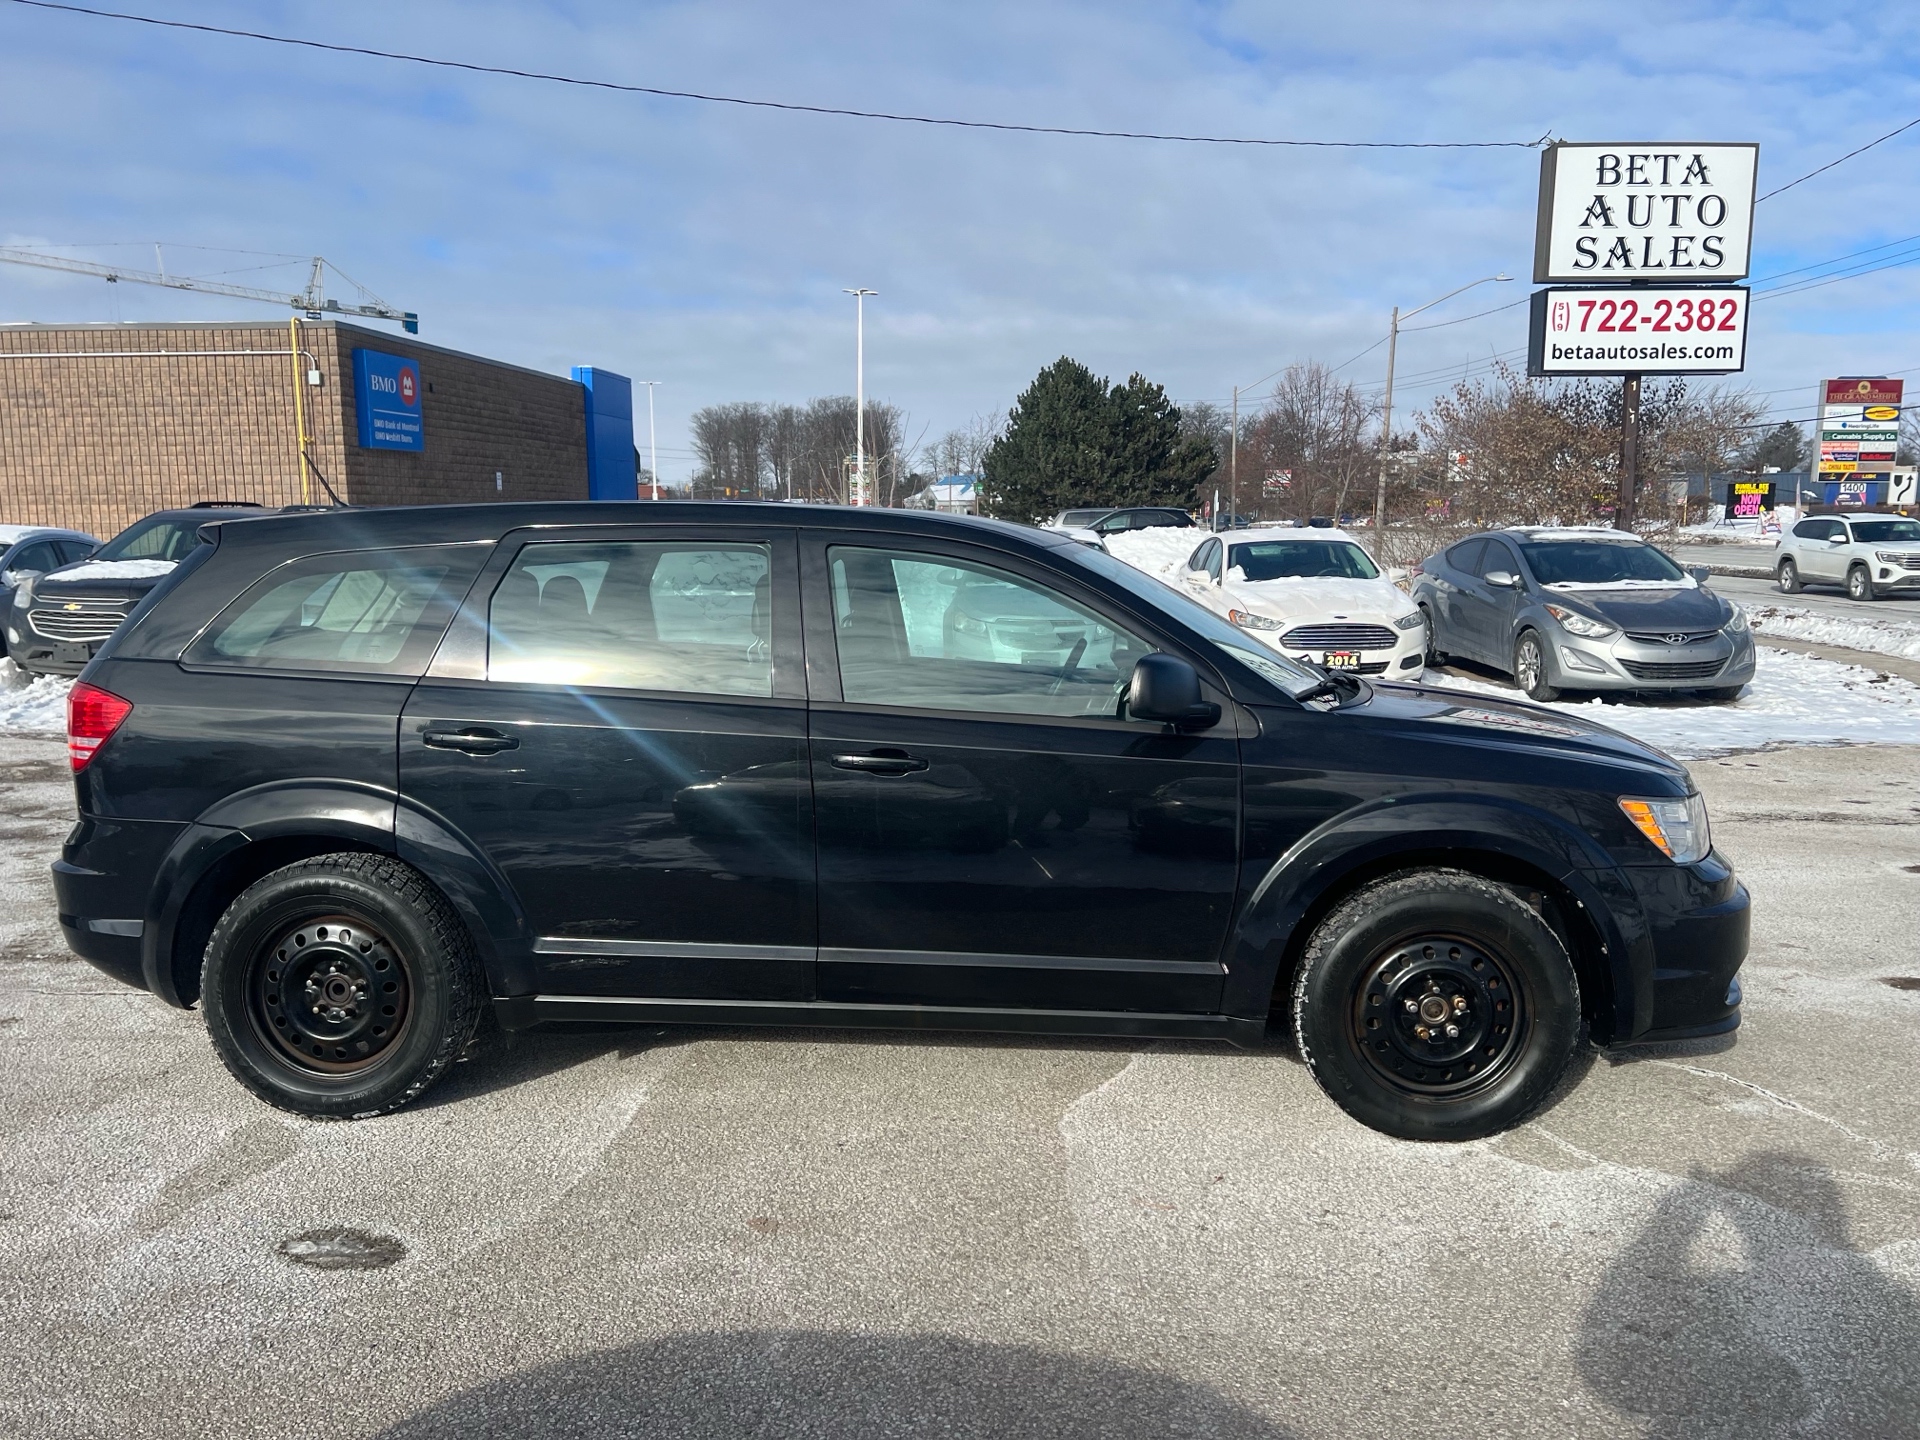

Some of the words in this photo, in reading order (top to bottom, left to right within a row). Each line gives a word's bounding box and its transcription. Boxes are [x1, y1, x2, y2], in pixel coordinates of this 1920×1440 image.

[1596, 154, 1713, 187] BETA
[1578, 194, 1729, 229] AUTO
[1572, 235, 1726, 270] SALES
[1577, 299, 1738, 332] 722-2382
[1551, 343, 1734, 360] betaautosales.com
[371, 375, 396, 393] BMO
[1862, 432, 1886, 440] Supply
[1842, 484, 1865, 492] 1400
[1741, 494, 1761, 505] NOW
[1734, 504, 1759, 515] OPEN
[1327, 656, 1358, 666] 2014
